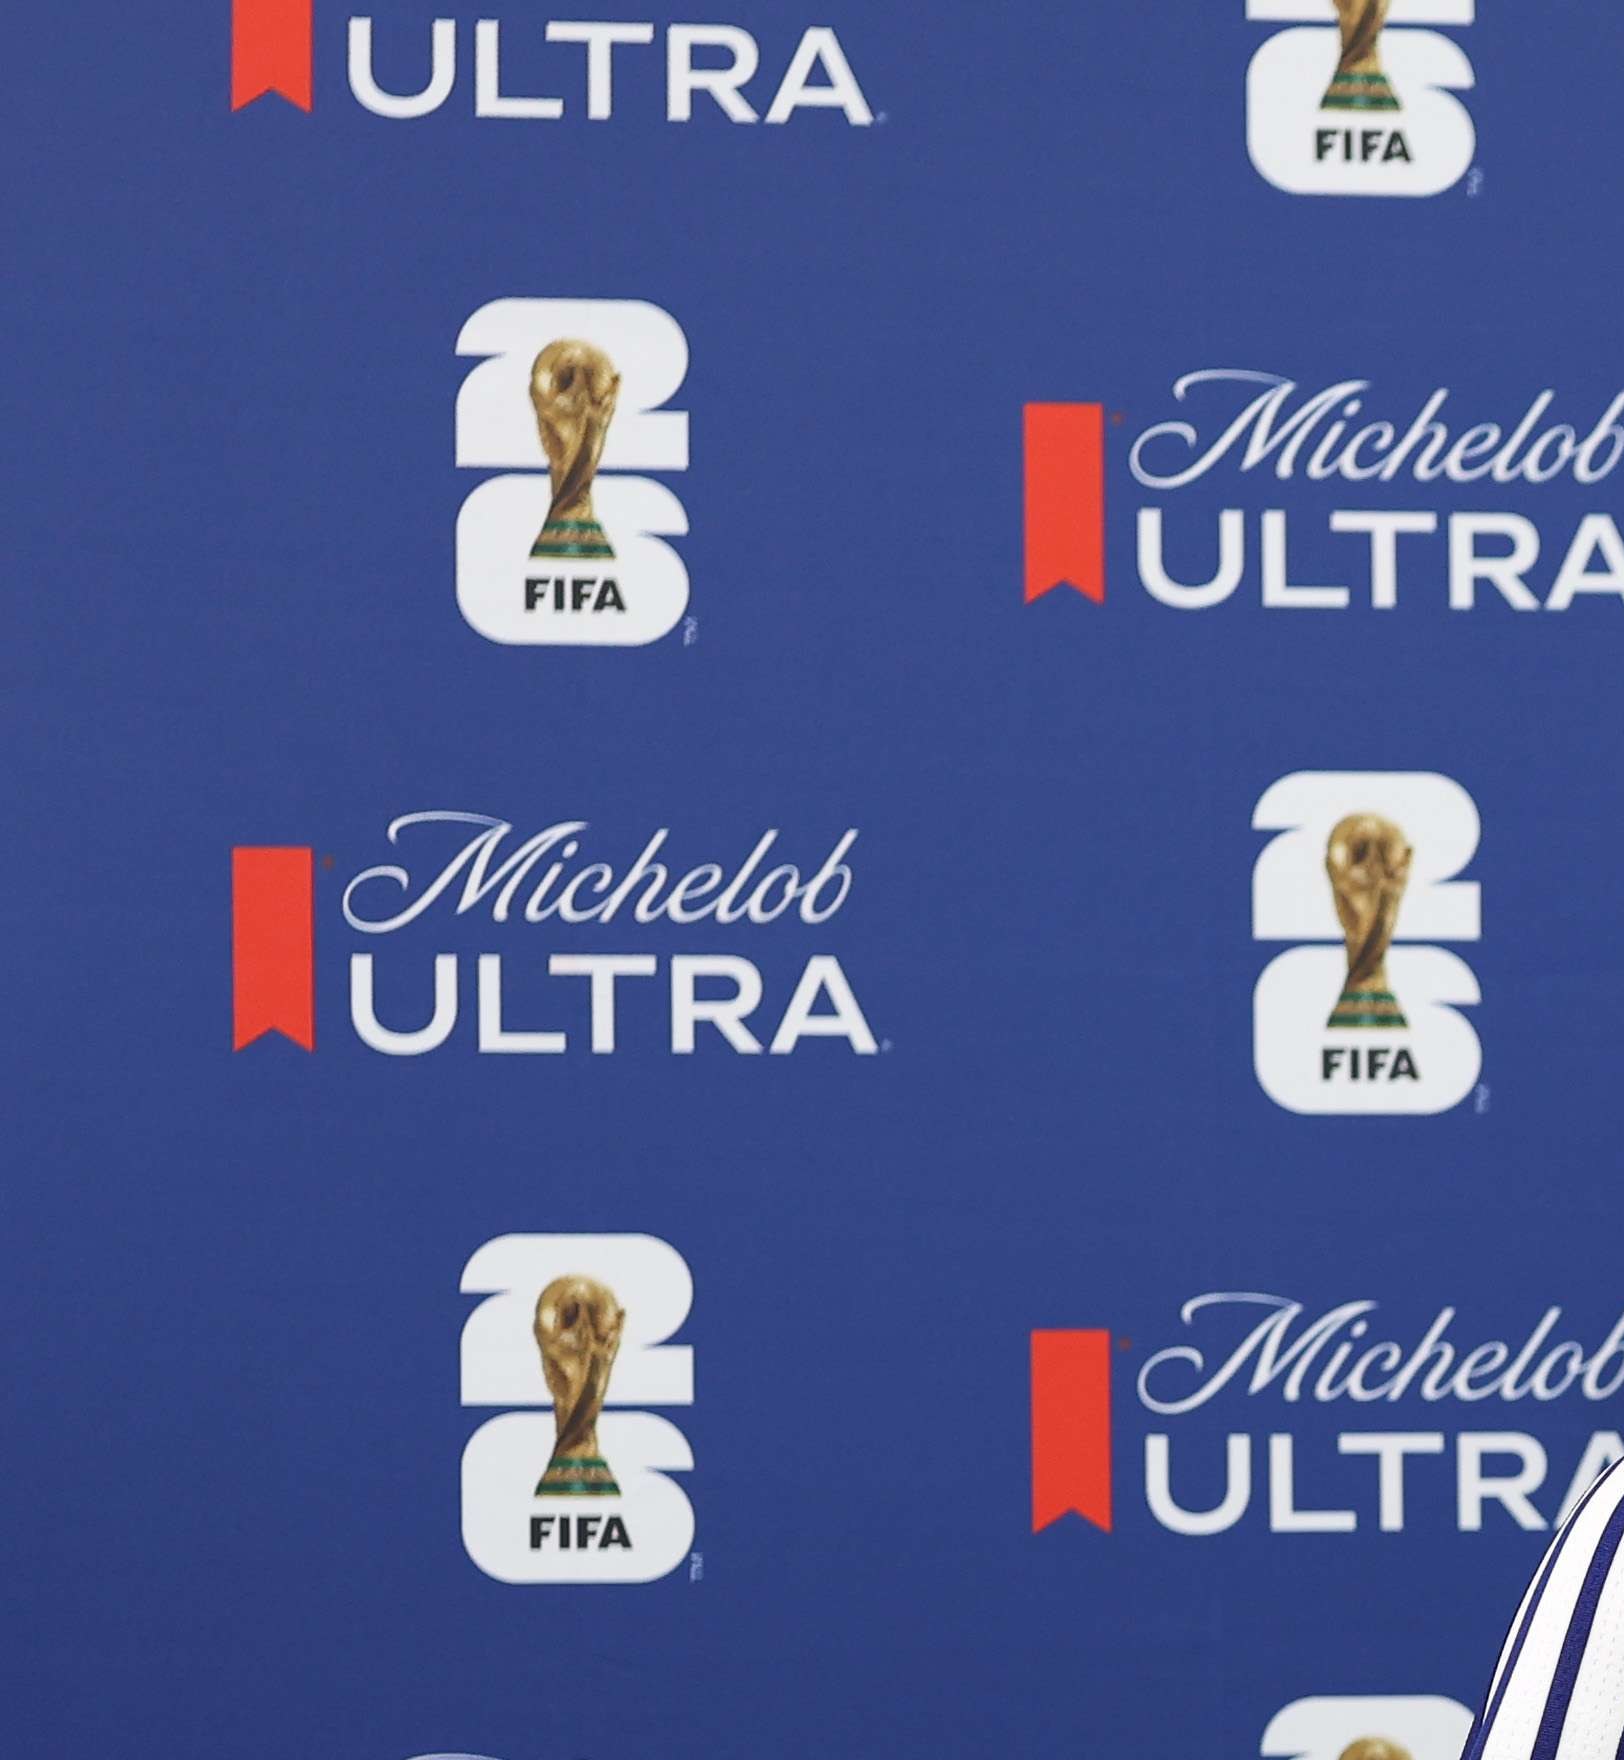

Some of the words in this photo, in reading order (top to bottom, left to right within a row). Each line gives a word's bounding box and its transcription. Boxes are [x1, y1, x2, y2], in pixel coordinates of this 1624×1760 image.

[347, 16, 875, 127] ULTRA
[1314, 127, 1413, 164] FIFA
[523, 576, 628, 613] FIFA
[341, 810, 858, 934] Michelob
[349, 952, 879, 1057] ULTRA
[1321, 1047, 1420, 1082] FIFA
[528, 1514, 634, 1551] FIFA
